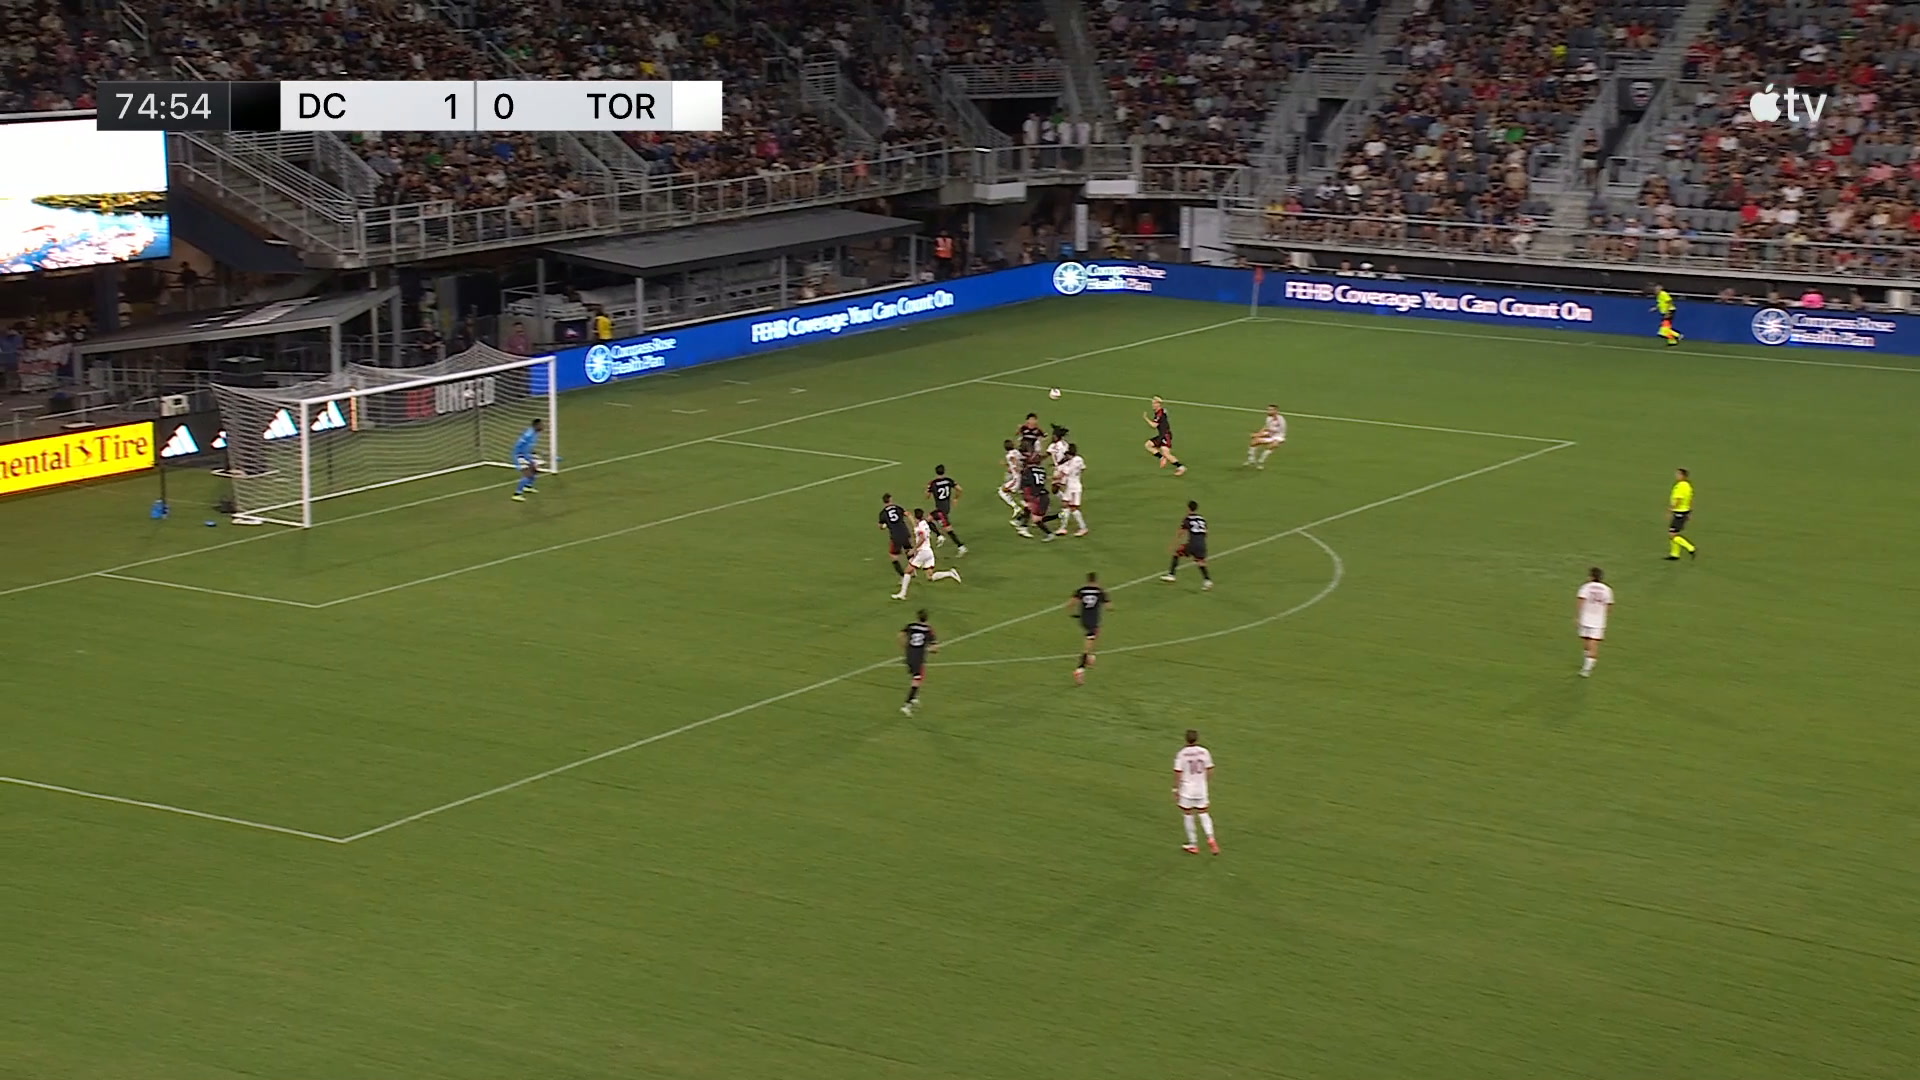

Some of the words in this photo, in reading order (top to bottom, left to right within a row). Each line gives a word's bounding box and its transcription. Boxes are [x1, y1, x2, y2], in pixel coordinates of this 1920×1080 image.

[1285, 281, 1335, 302] FEHB
[1335, 285, 1422, 312] Coverage
[1421, 291, 1459, 311] You
[1459, 294, 1498, 314] Can
[1500, 297, 1560, 319] Count
[1560, 301, 1593, 322] On
[751, 319, 788, 343] FEHB
[788, 311, 849, 336] Coverage
[847, 304, 873, 324] You
[872, 301, 898, 320] Can
[897, 293, 935, 316] Count
[934, 289, 955, 308] On
[94, 434, 149, 463] Tire
[937, 485, 950, 500] 21
[887, 509, 899, 522] 5
[1187, 758, 1205, 775] 10
